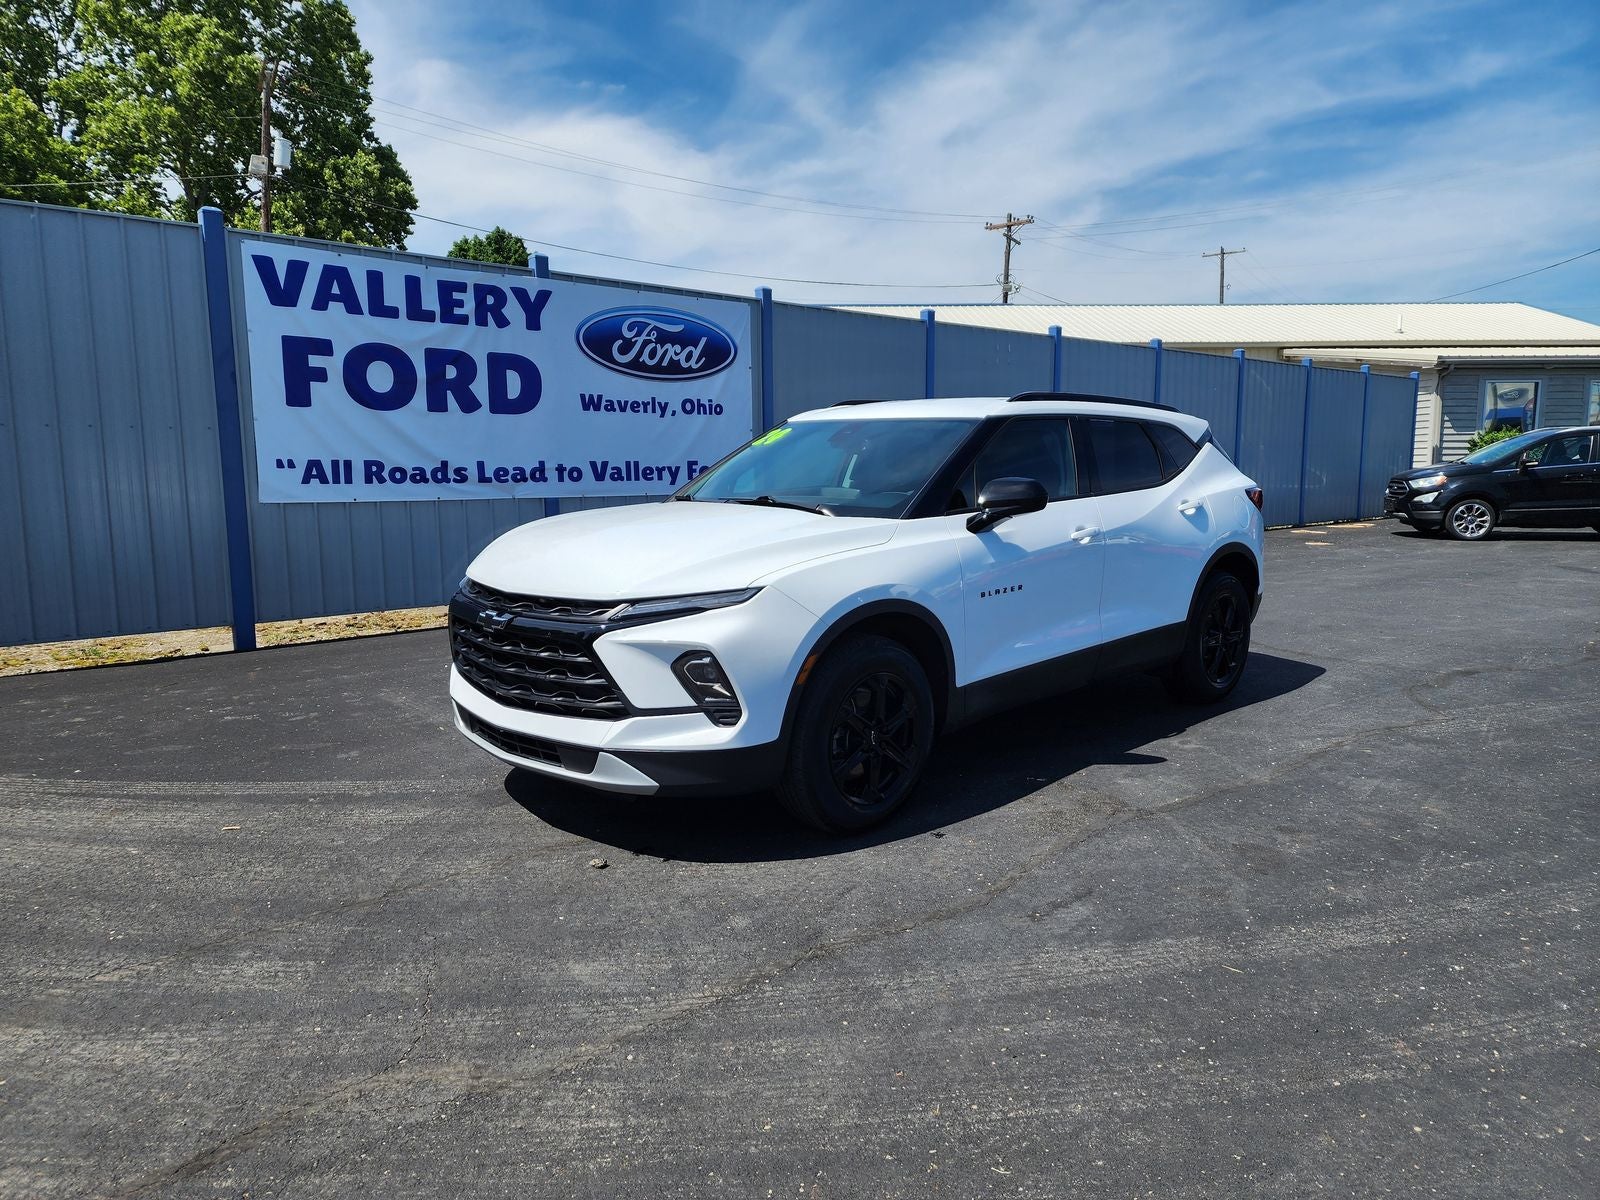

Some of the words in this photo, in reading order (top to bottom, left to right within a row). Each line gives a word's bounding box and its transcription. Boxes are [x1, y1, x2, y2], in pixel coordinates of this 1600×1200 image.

[251, 254, 552, 331] VALLERY
[612, 317, 707, 369] Ford
[281, 335, 543, 415] FORD
[580, 393, 677, 418] Waverly,
[681, 398, 724, 416] Ohio
[363, 459, 469, 484] Roads
[476, 460, 549, 484] Lead
[555, 463, 583, 483] to
[589, 460, 681, 486] Vallery
[980, 584, 1023, 598] BLAZER
